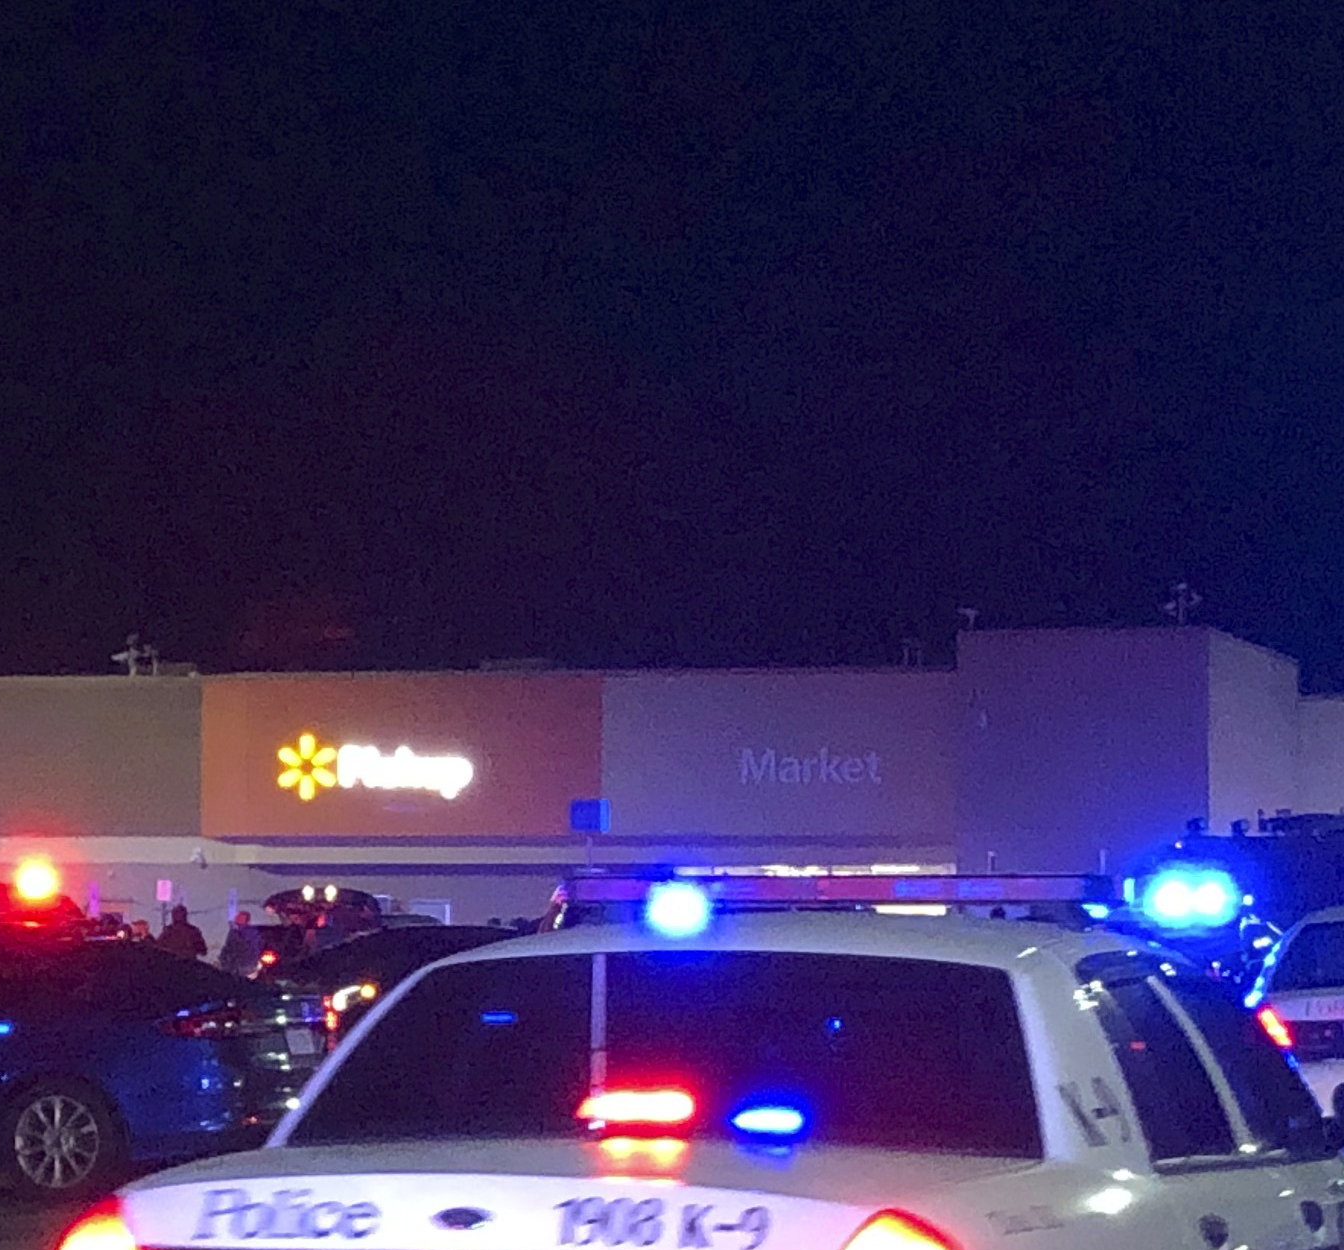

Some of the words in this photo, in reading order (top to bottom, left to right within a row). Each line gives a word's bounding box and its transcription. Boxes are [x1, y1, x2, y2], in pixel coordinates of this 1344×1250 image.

[739, 747, 882, 784] Market
[191, 1187, 382, 1240] Police
[554, 1196, 666, 1248] 1908
[677, 1203, 773, 1250] K-9
